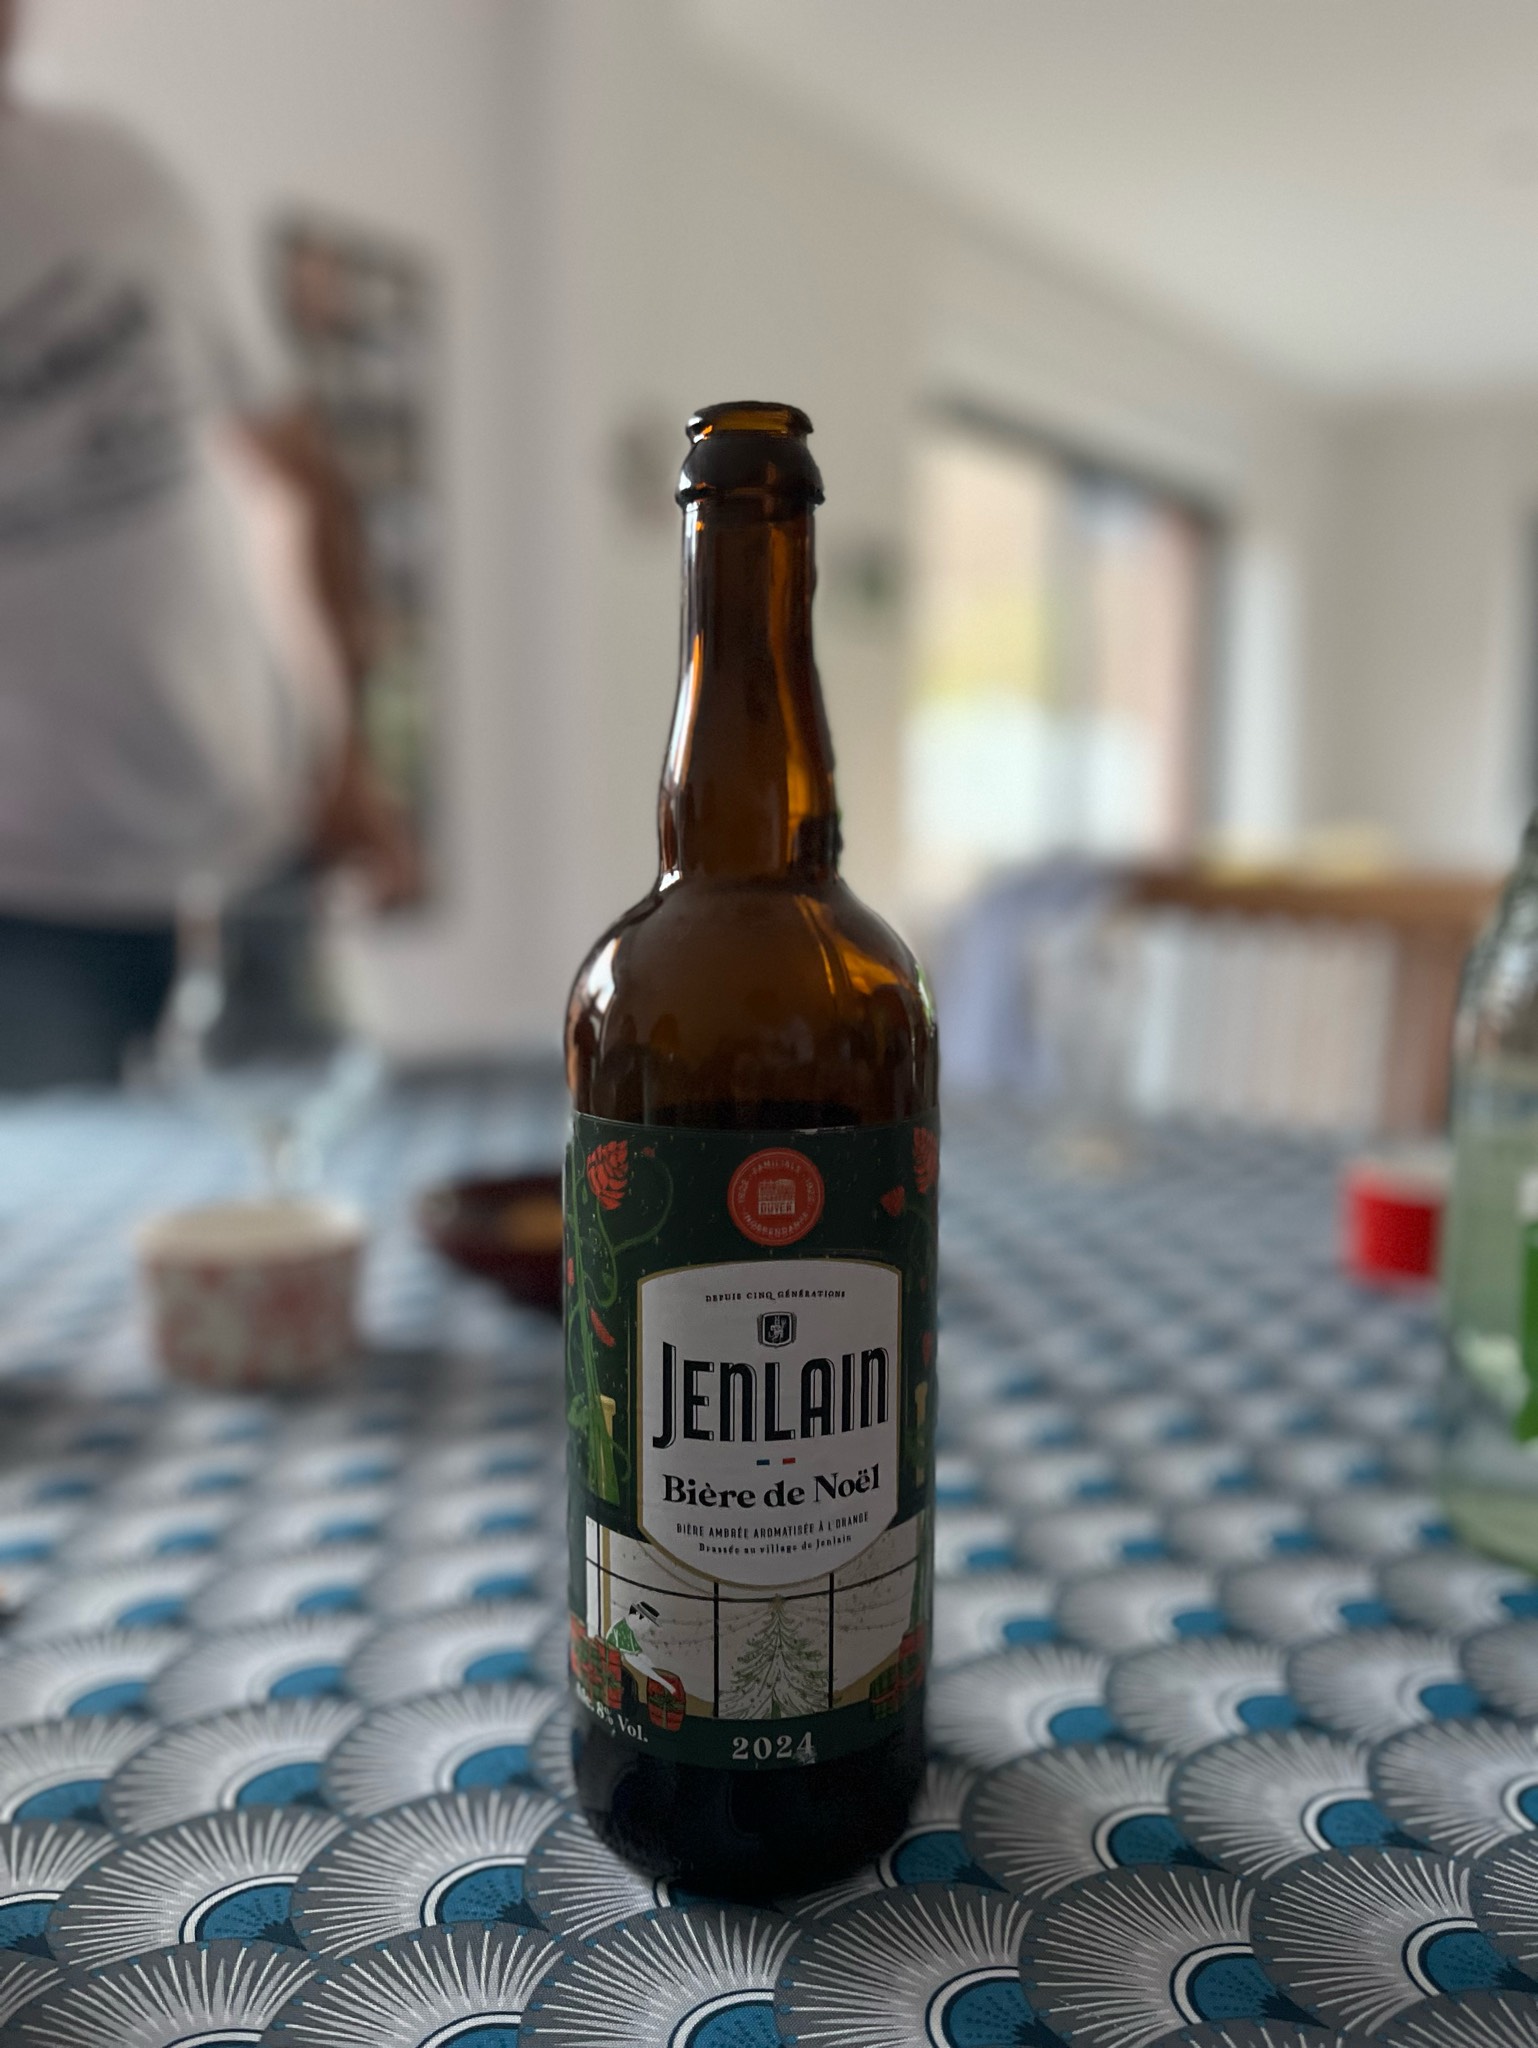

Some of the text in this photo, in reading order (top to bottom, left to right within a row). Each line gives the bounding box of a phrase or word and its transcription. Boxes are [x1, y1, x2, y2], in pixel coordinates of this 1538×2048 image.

[705, 1288, 846, 1303] DEPUIS CINQ GÉNÉRATIONS
[652, 1341, 889, 1449] JENLAIN
[662, 1462, 880, 1508] Bière de Noël
[676, 1522, 705, 1537] BIÈRE
[708, 1526, 749, 1540] AMBRÉE
[753, 1522, 815, 1539] AROMATISÉE
[818, 1519, 824, 1532] À
[760, 1543, 797, 1555] village
[801, 1540, 813, 1551] de
[816, 1535, 852, 1551] Jenlain
[617, 1714, 648, 1743] Vol.
[732, 1731, 816, 1763] 2024
